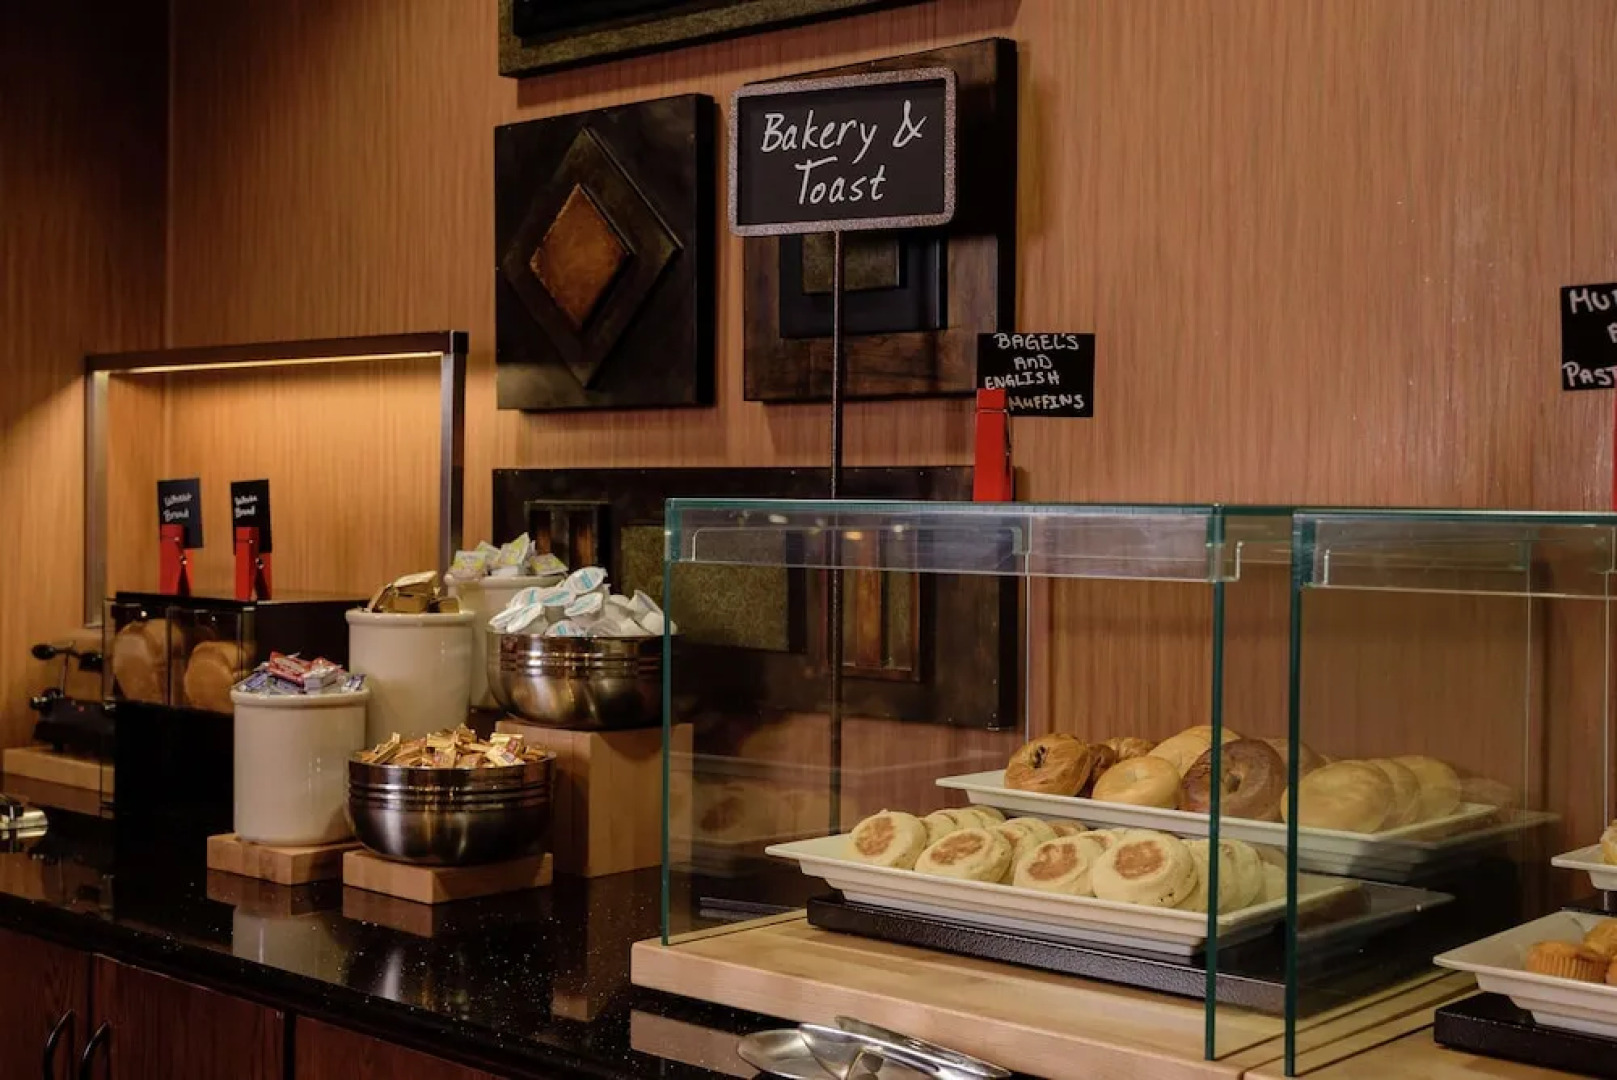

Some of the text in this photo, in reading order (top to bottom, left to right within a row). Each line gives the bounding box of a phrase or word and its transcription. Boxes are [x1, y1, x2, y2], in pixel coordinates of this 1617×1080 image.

[761, 99, 928, 164] Bakery &
[794, 156, 887, 205] Toast
[992, 332, 1080, 351] BAGEL'S
[985, 370, 1061, 390] ENGLISH
[1009, 394, 1085, 411] MUFFINS
